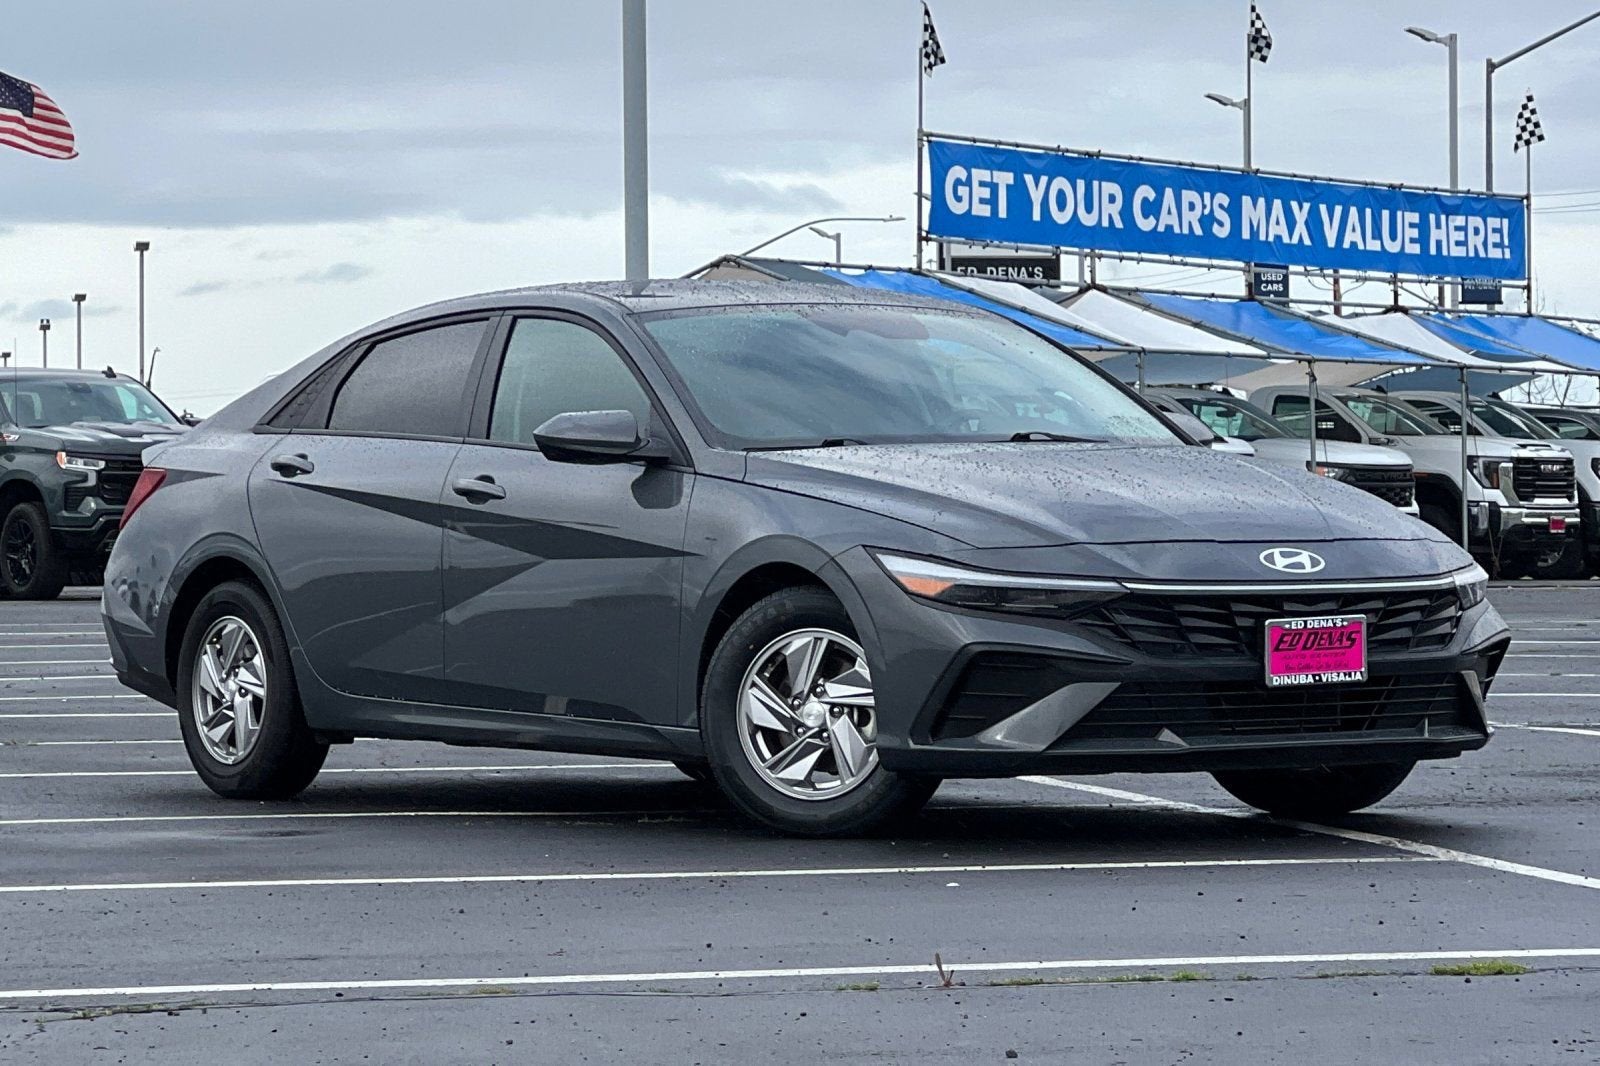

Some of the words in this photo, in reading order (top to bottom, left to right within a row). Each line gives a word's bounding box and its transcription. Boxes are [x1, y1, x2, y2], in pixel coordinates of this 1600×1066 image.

[944, 165, 1014, 219] GET
[1024, 174, 1123, 229] YOUR
[1133, 185, 1231, 238] CAR'S
[1241, 195, 1312, 246] MAX
[1319, 203, 1420, 254] VALUE
[1429, 212, 1511, 259] HERE!
[986, 266, 1043, 280] DENA'S
[1260, 273, 1283, 281] USED
[1260, 283, 1284, 291] CARS
[1291, 620, 1304, 629] ED
[1306, 618, 1343, 629] DENA'S
[1274, 631, 1302, 652] ED
[1272, 674, 1314, 685] DINUBA
